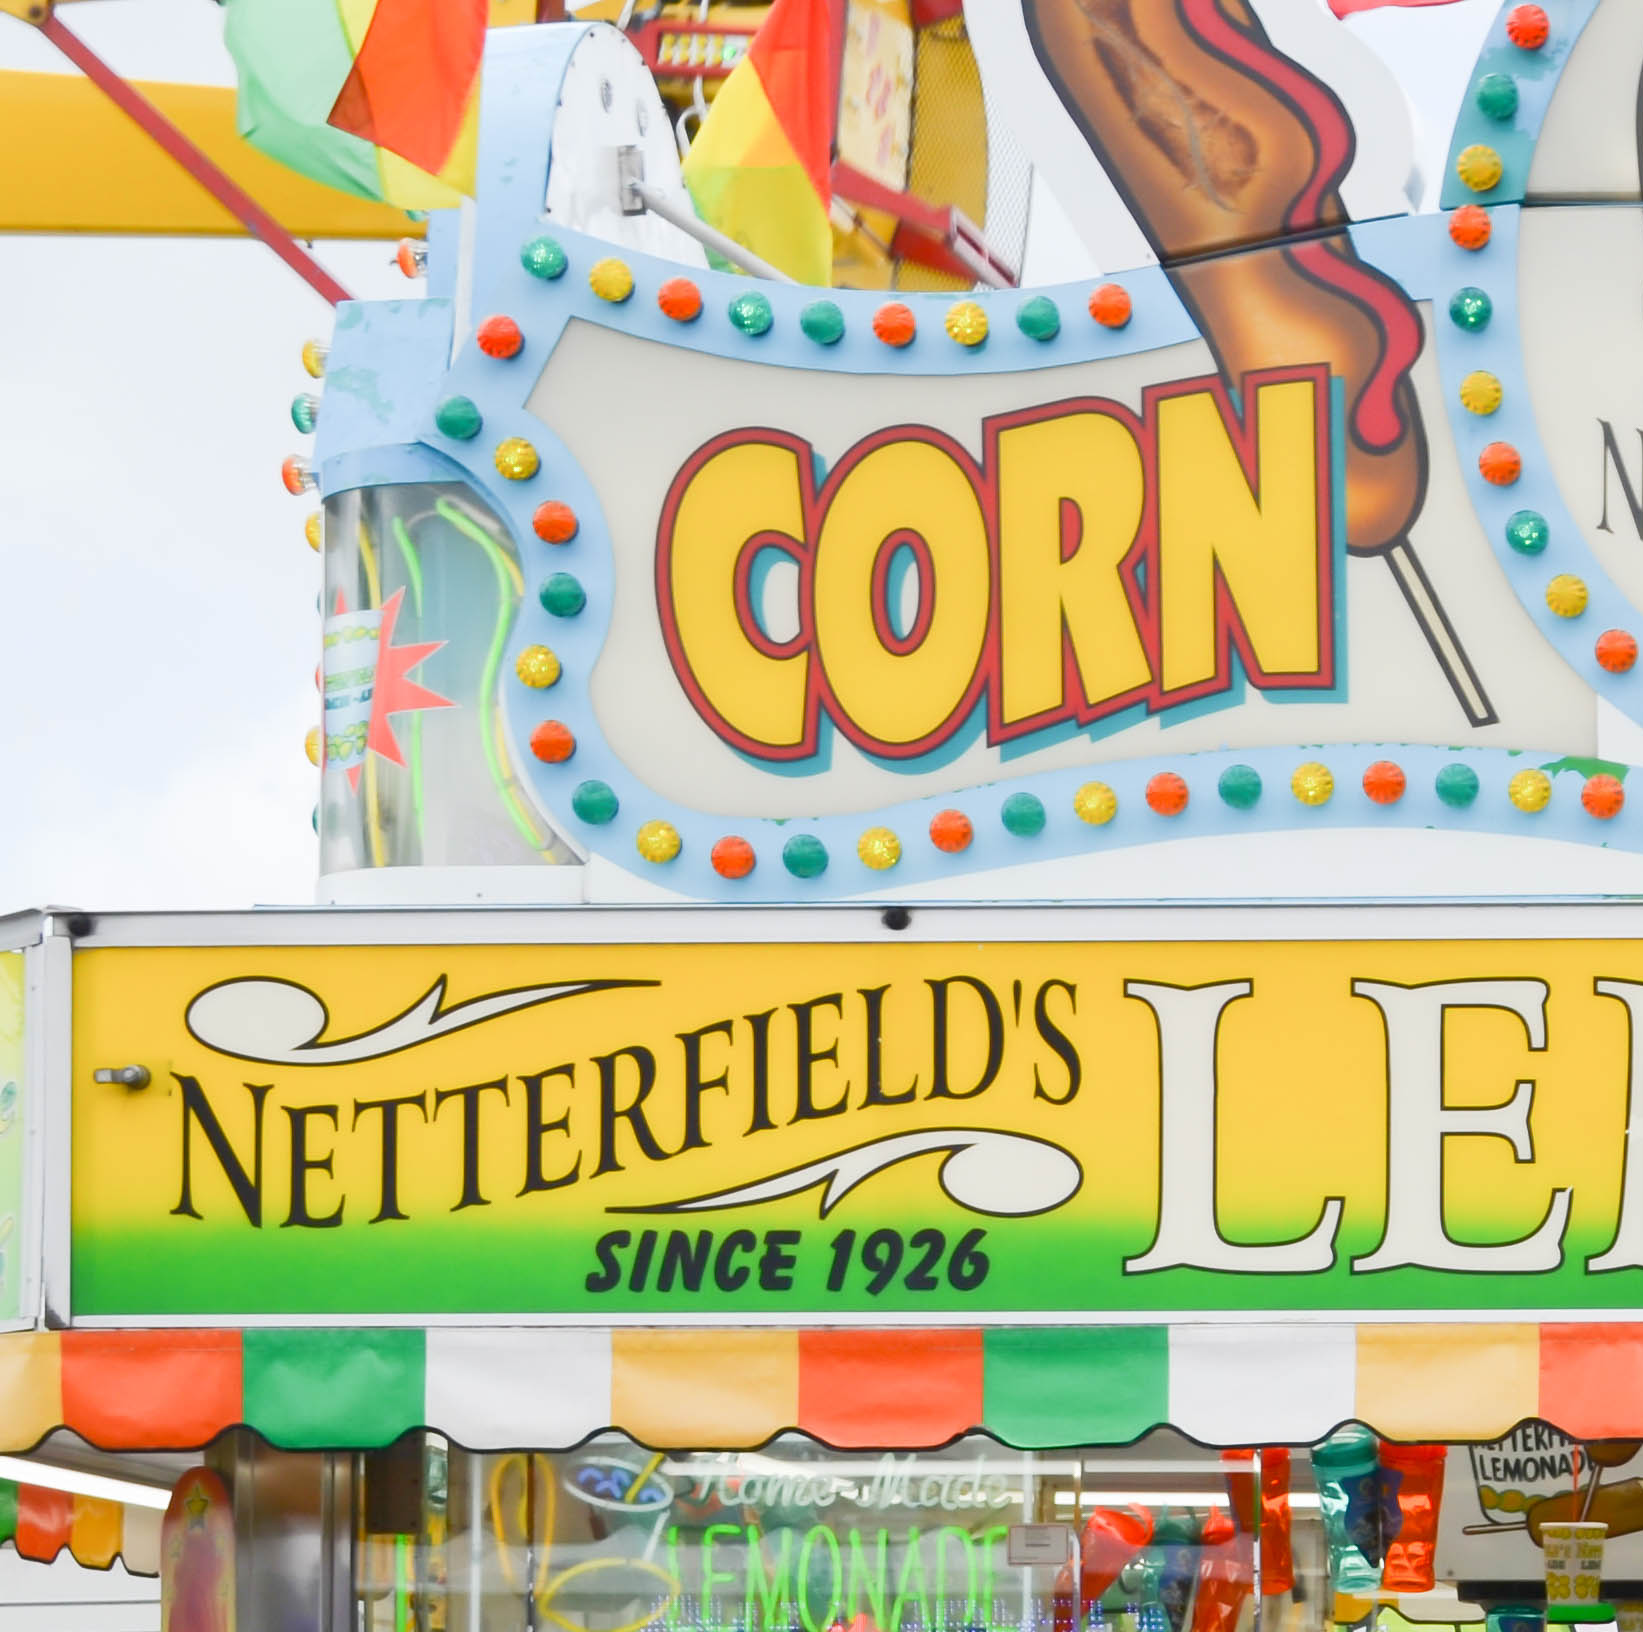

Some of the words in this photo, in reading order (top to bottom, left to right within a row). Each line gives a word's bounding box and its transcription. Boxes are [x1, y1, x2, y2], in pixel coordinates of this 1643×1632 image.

[655, 363, 1345, 768] CORN
[169, 975, 1083, 1229] NETTERFIELD'S
[585, 1229, 800, 1293] SINCE
[826, 1228, 990, 1295] 1926
